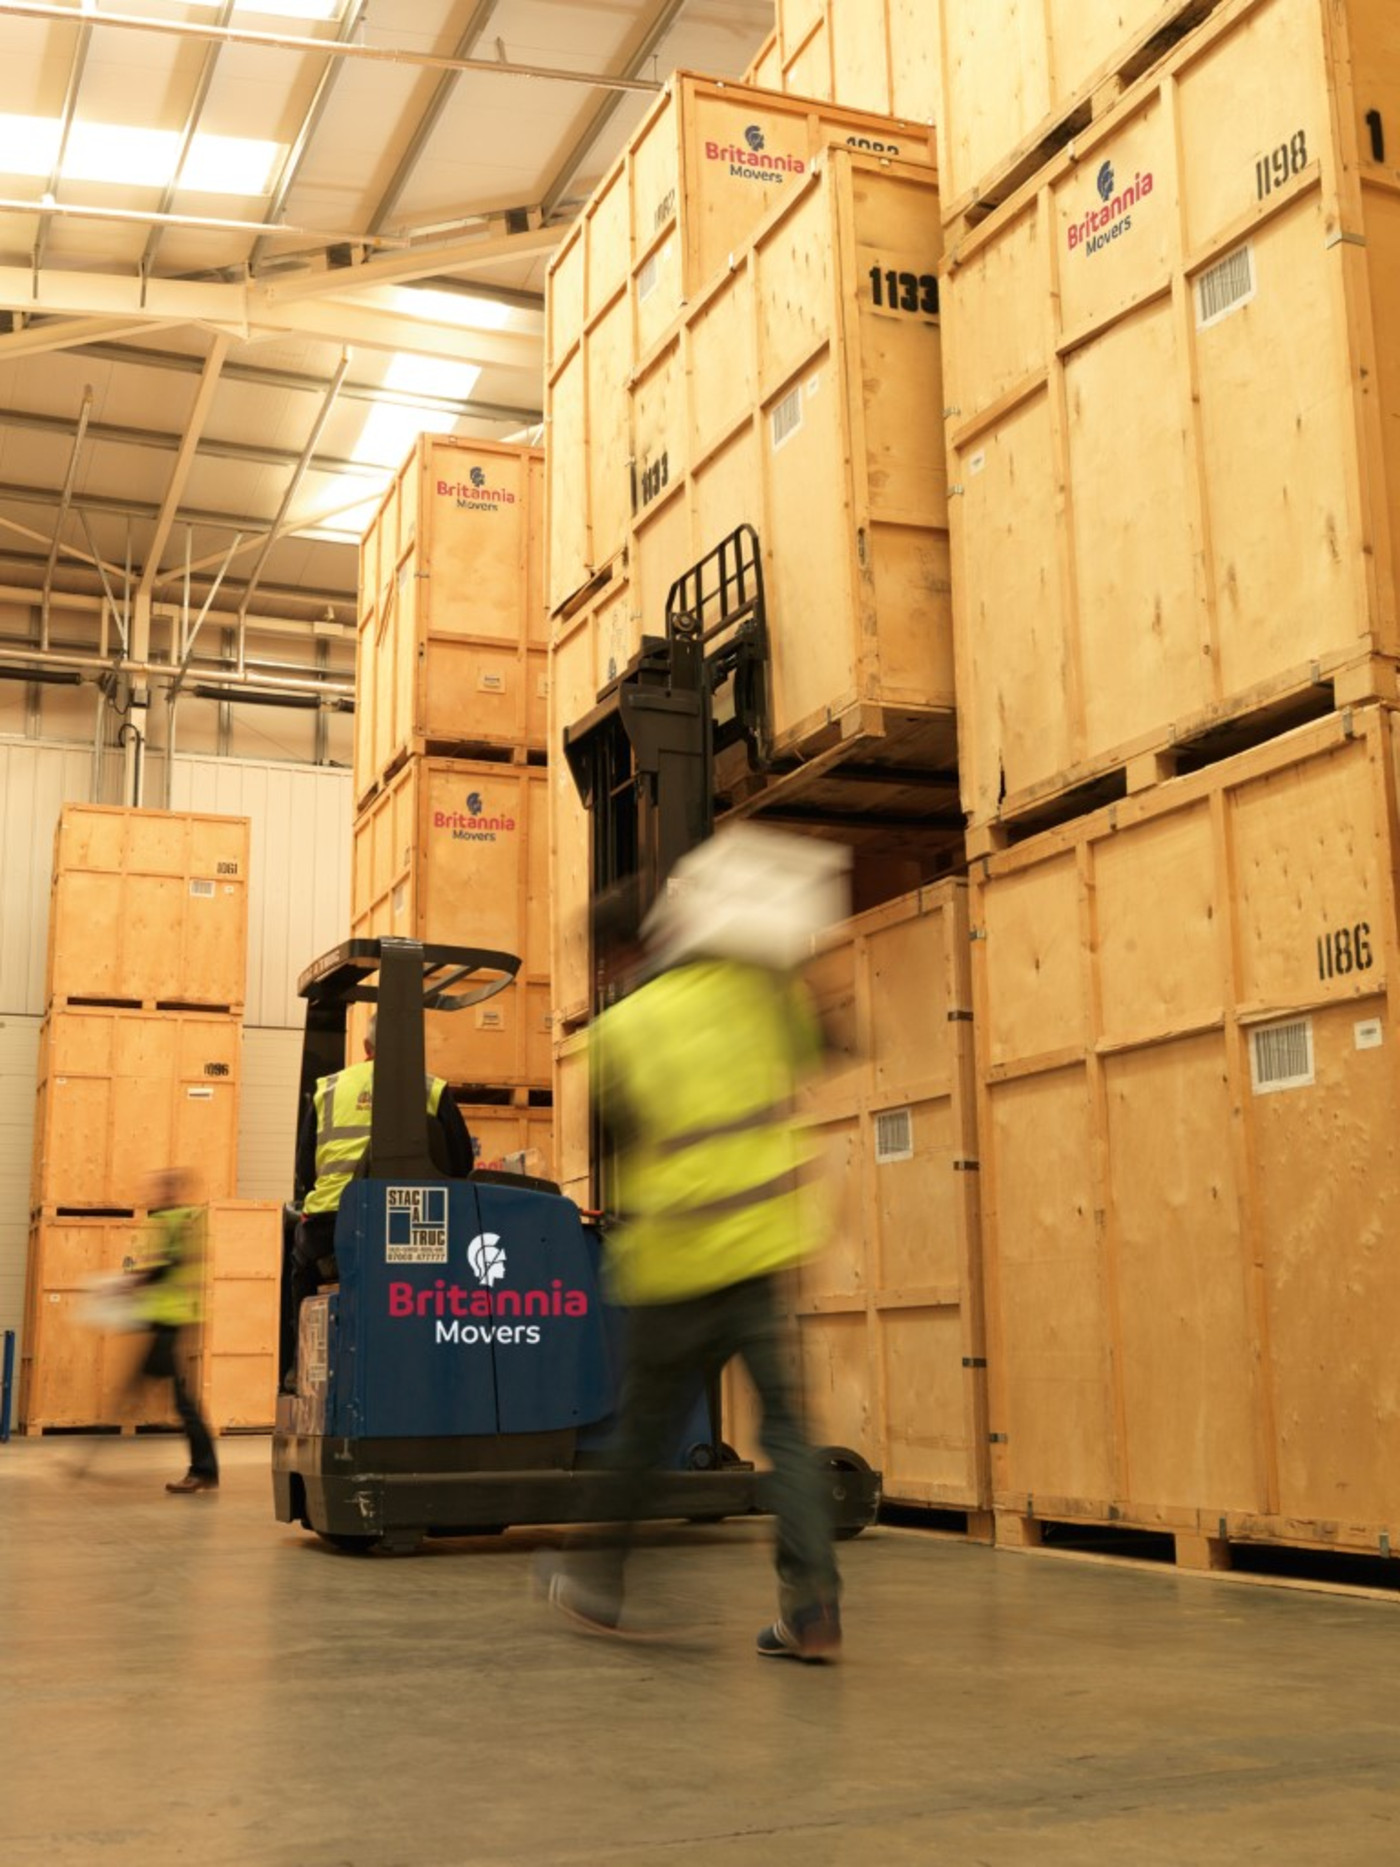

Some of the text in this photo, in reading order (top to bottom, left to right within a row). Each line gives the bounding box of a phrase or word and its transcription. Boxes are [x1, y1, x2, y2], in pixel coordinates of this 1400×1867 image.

[705, 141, 806, 174] Britannia
[1255, 129, 1308, 202] 1198
[729, 163, 784, 184] Movers
[1066, 170, 1154, 251] Britannia
[1085, 213, 1132, 258] Movers
[868, 265, 940, 315] 1133
[437, 480, 515, 504] Britannia
[456, 498, 499, 512] Movers
[434, 811, 516, 832] Britannia
[452, 829, 497, 842] Movers
[1316, 921, 1373, 981] 1186
[388, 1189, 420, 1206] STAC
[411, 1206, 420, 1223] A
[412, 1229, 446, 1246] TRUC
[387, 1278, 589, 1318] Britannia
[435, 1319, 541, 1344] Movers
